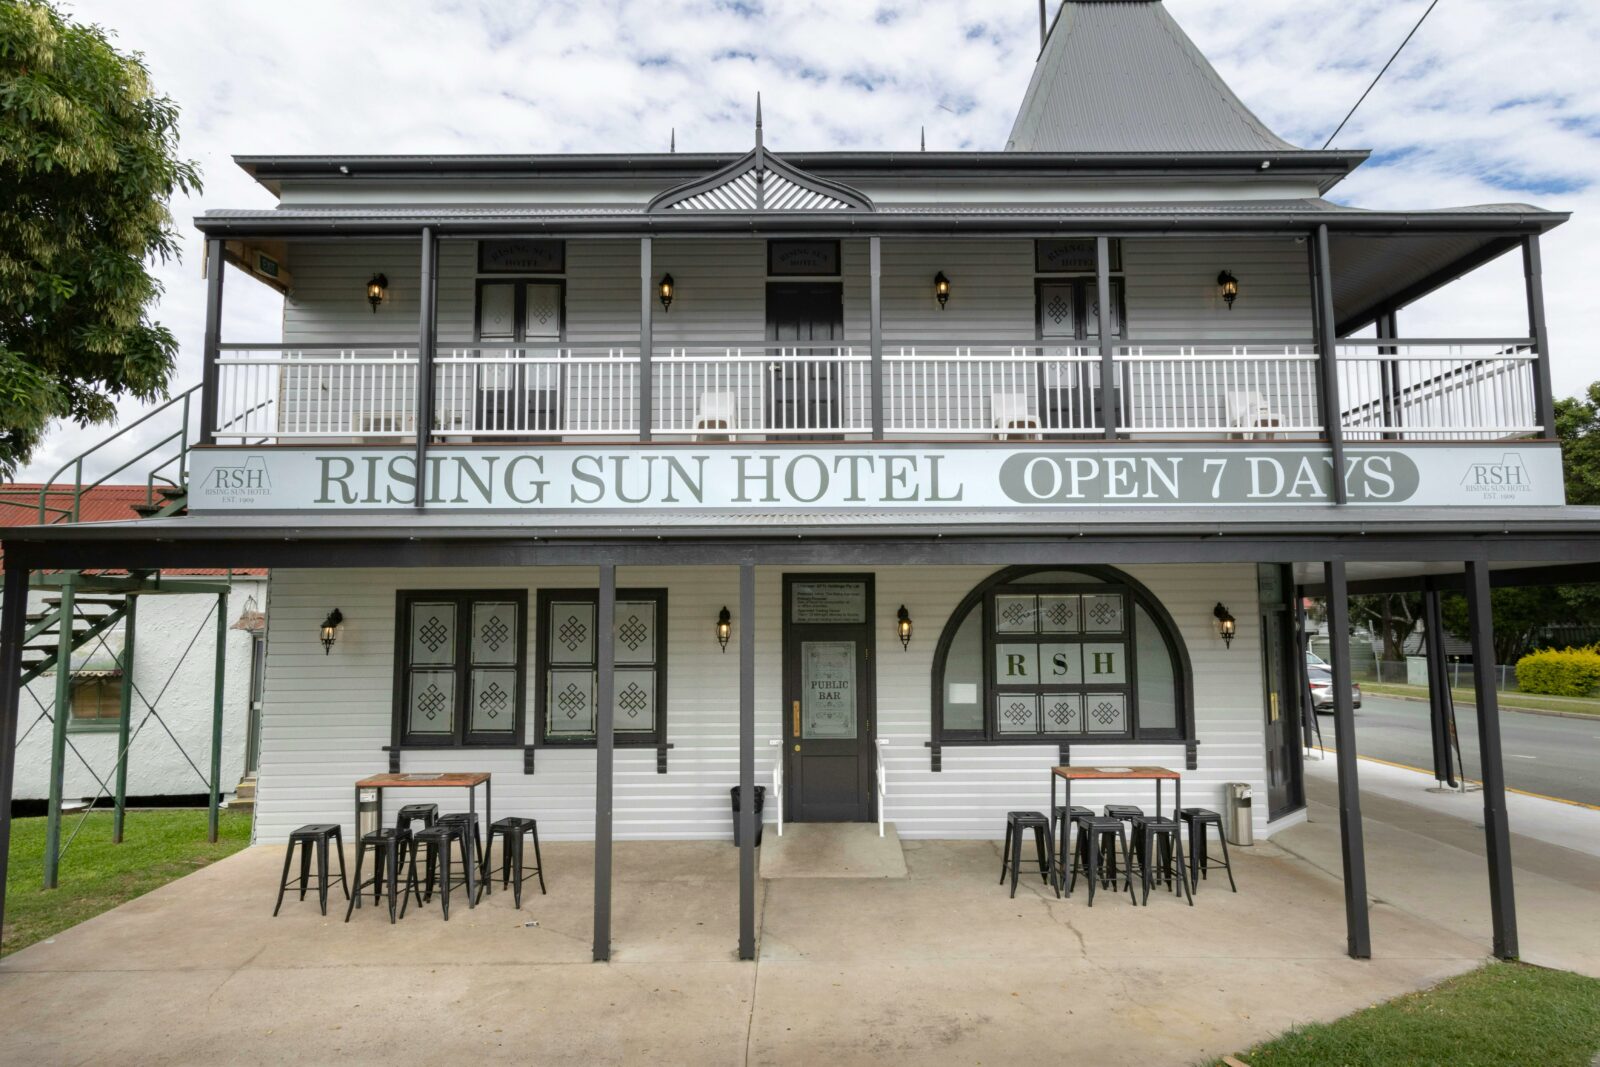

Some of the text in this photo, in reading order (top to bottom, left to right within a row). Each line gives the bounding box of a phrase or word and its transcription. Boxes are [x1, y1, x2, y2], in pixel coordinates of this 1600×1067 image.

[215, 469, 264, 488] RSH
[313, 455, 551, 505] RISING
[571, 455, 710, 504] SUN
[731, 455, 963, 503] HOTEL
[1023, 456, 1183, 499] OPEN
[1202, 457, 1227, 499] 7
[1474, 466, 1522, 485] RSH
[247, 488, 271, 496] HOTEL
[811, 680, 849, 690] PUBLIC
[818, 692, 841, 700] BAR
